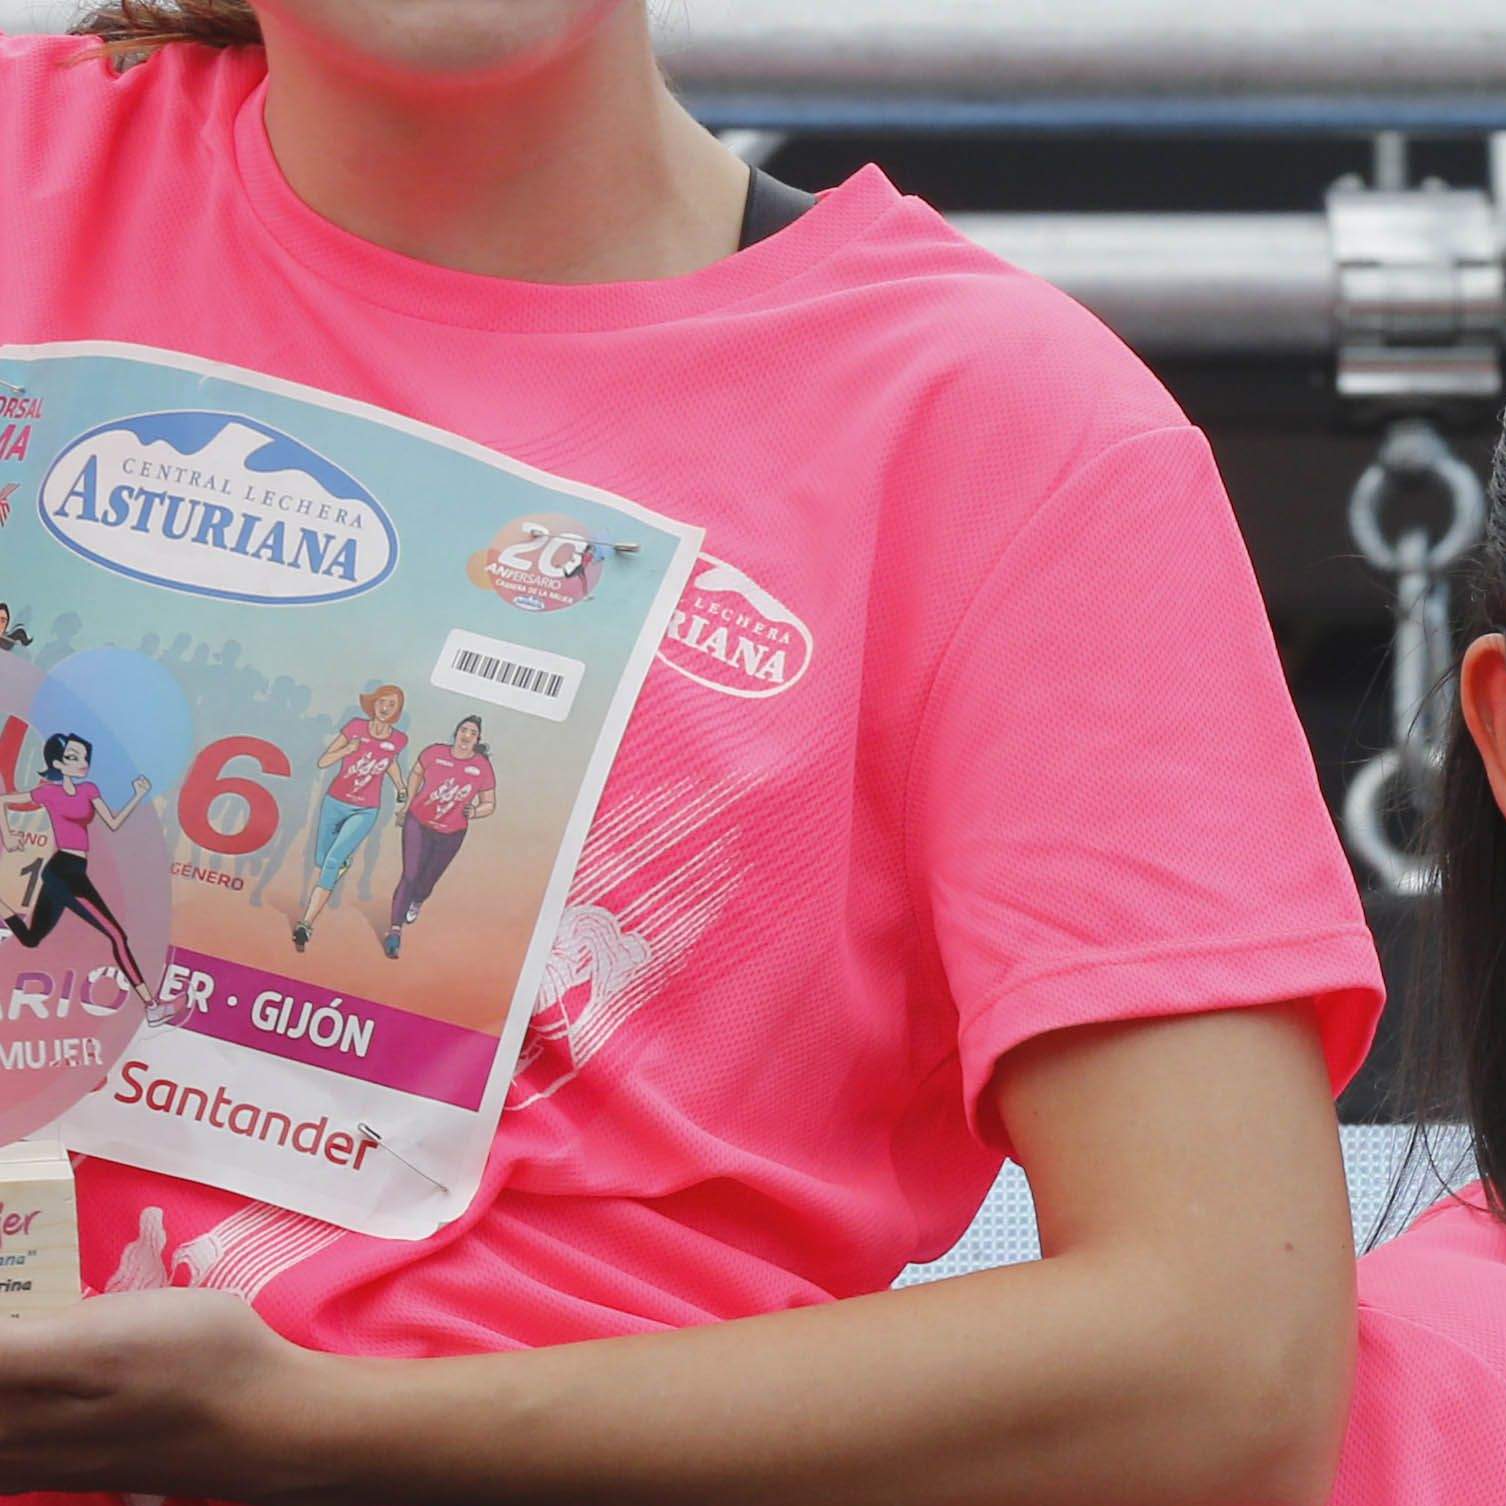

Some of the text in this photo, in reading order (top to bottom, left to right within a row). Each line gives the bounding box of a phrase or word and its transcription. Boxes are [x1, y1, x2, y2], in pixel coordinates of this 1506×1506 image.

[53, 454, 359, 582] ASTURIANA
[121, 457, 364, 530] CENTRAL LECHERA
[498, 521, 590, 578] 20
[694, 598, 790, 644] LECHERA
[170, 862, 245, 891] GÉNERO
[0, 965, 130, 1020] RIO
[251, 997, 376, 1058] GIJÓN
[113, 1060, 382, 1171] Santander
